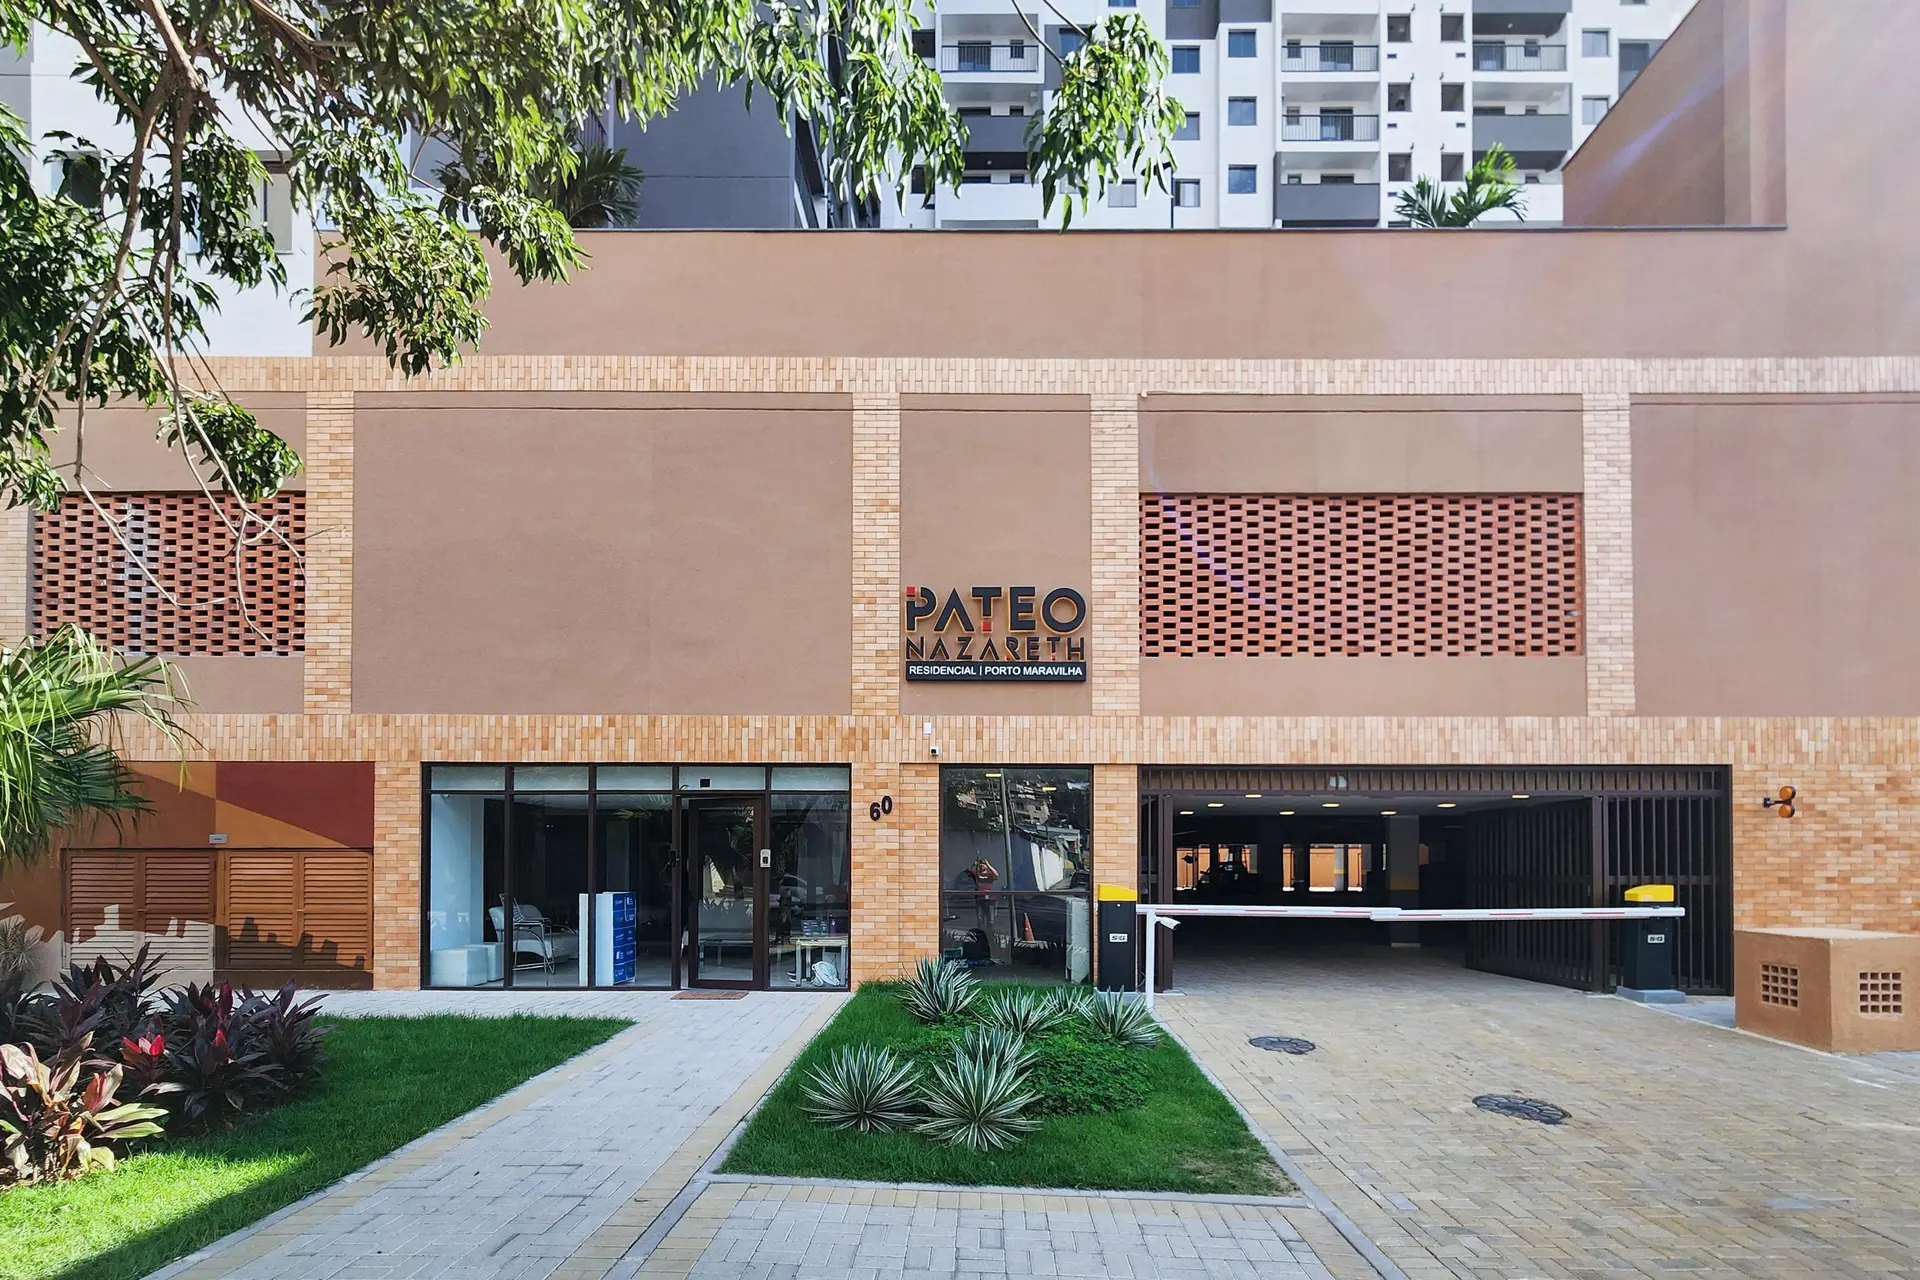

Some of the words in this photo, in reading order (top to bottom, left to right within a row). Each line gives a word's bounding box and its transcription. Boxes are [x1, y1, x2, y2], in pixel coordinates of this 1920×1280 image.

[906, 586, 1087, 633] PATEO
[906, 636, 1085, 661] NAZARETH
[909, 665, 977, 675] RESIDENCIAL
[984, 666, 1021, 676] PORTO
[1023, 666, 1083, 676] MARAVILHA
[870, 795, 892, 821] 60
